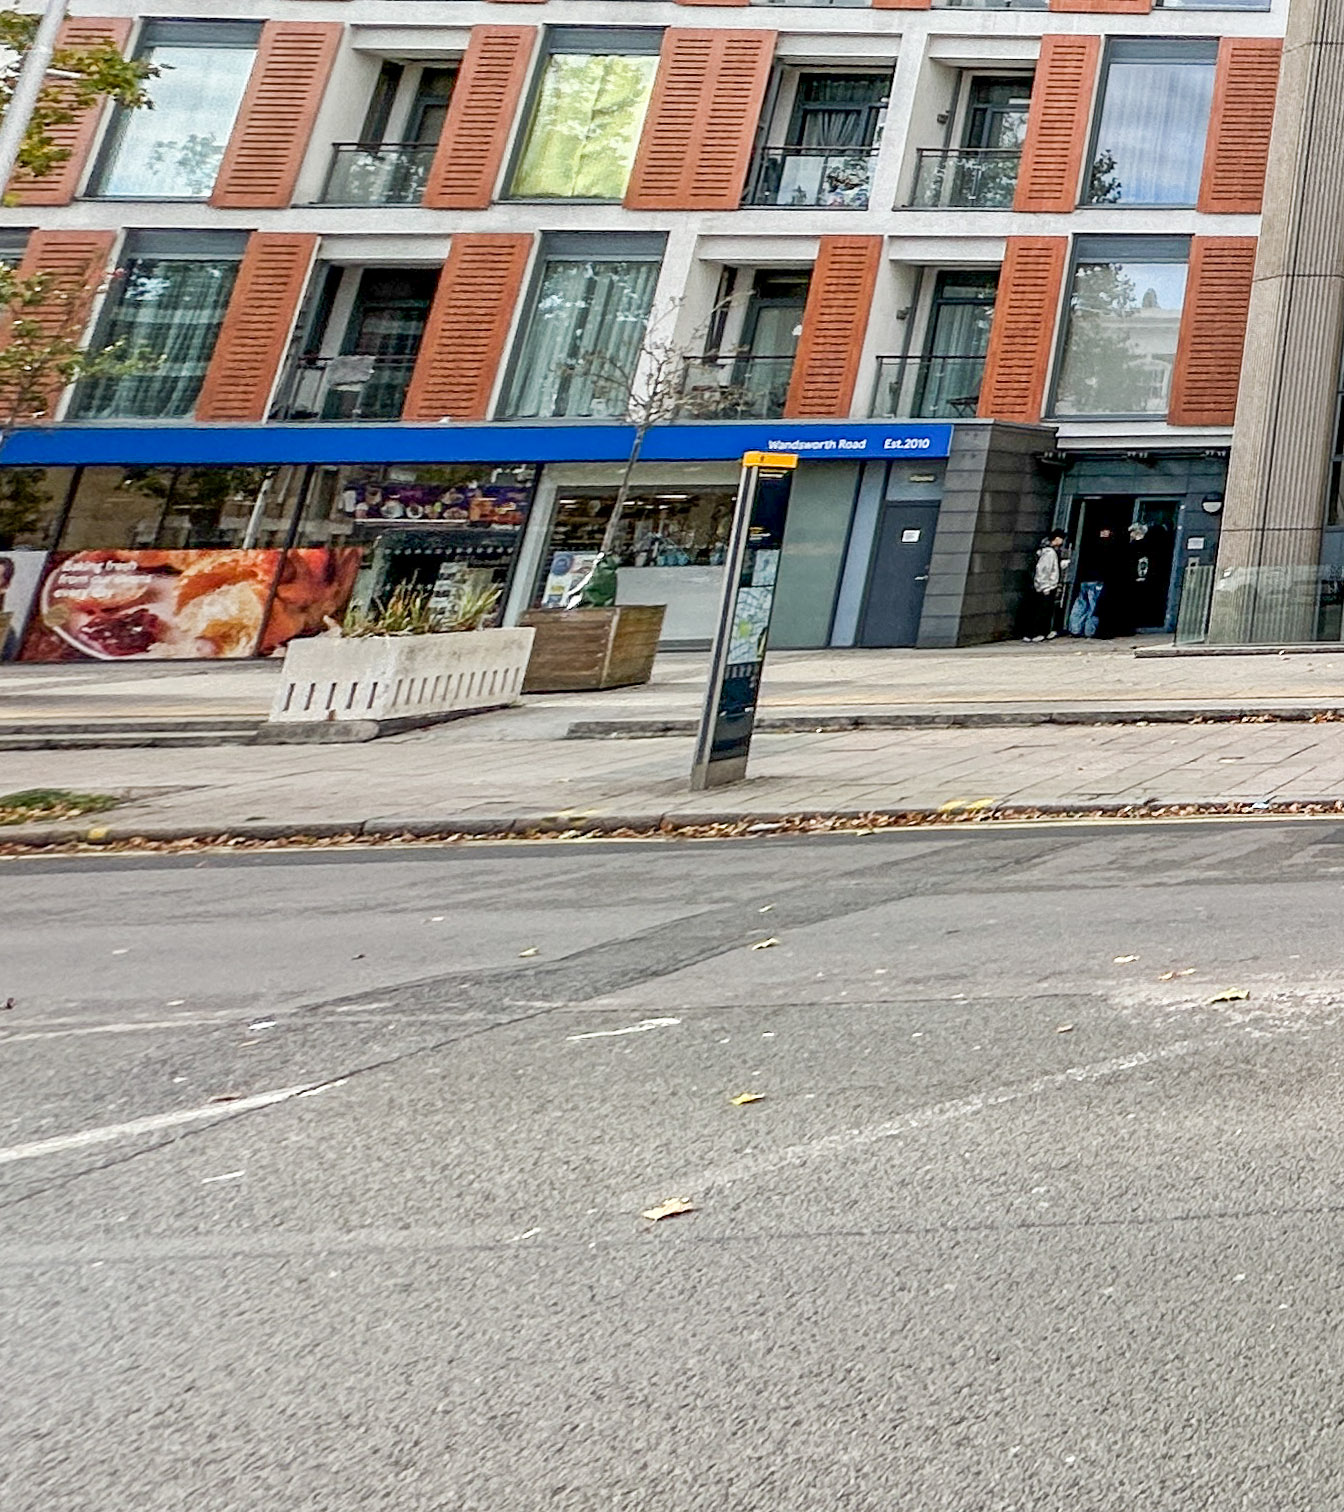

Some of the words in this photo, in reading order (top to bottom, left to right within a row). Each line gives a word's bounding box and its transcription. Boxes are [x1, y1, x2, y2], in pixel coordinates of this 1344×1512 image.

[768, 438, 836, 450] Wandsworth
[838, 438, 867, 450] Road
[884, 437, 930, 450] Est.2010
